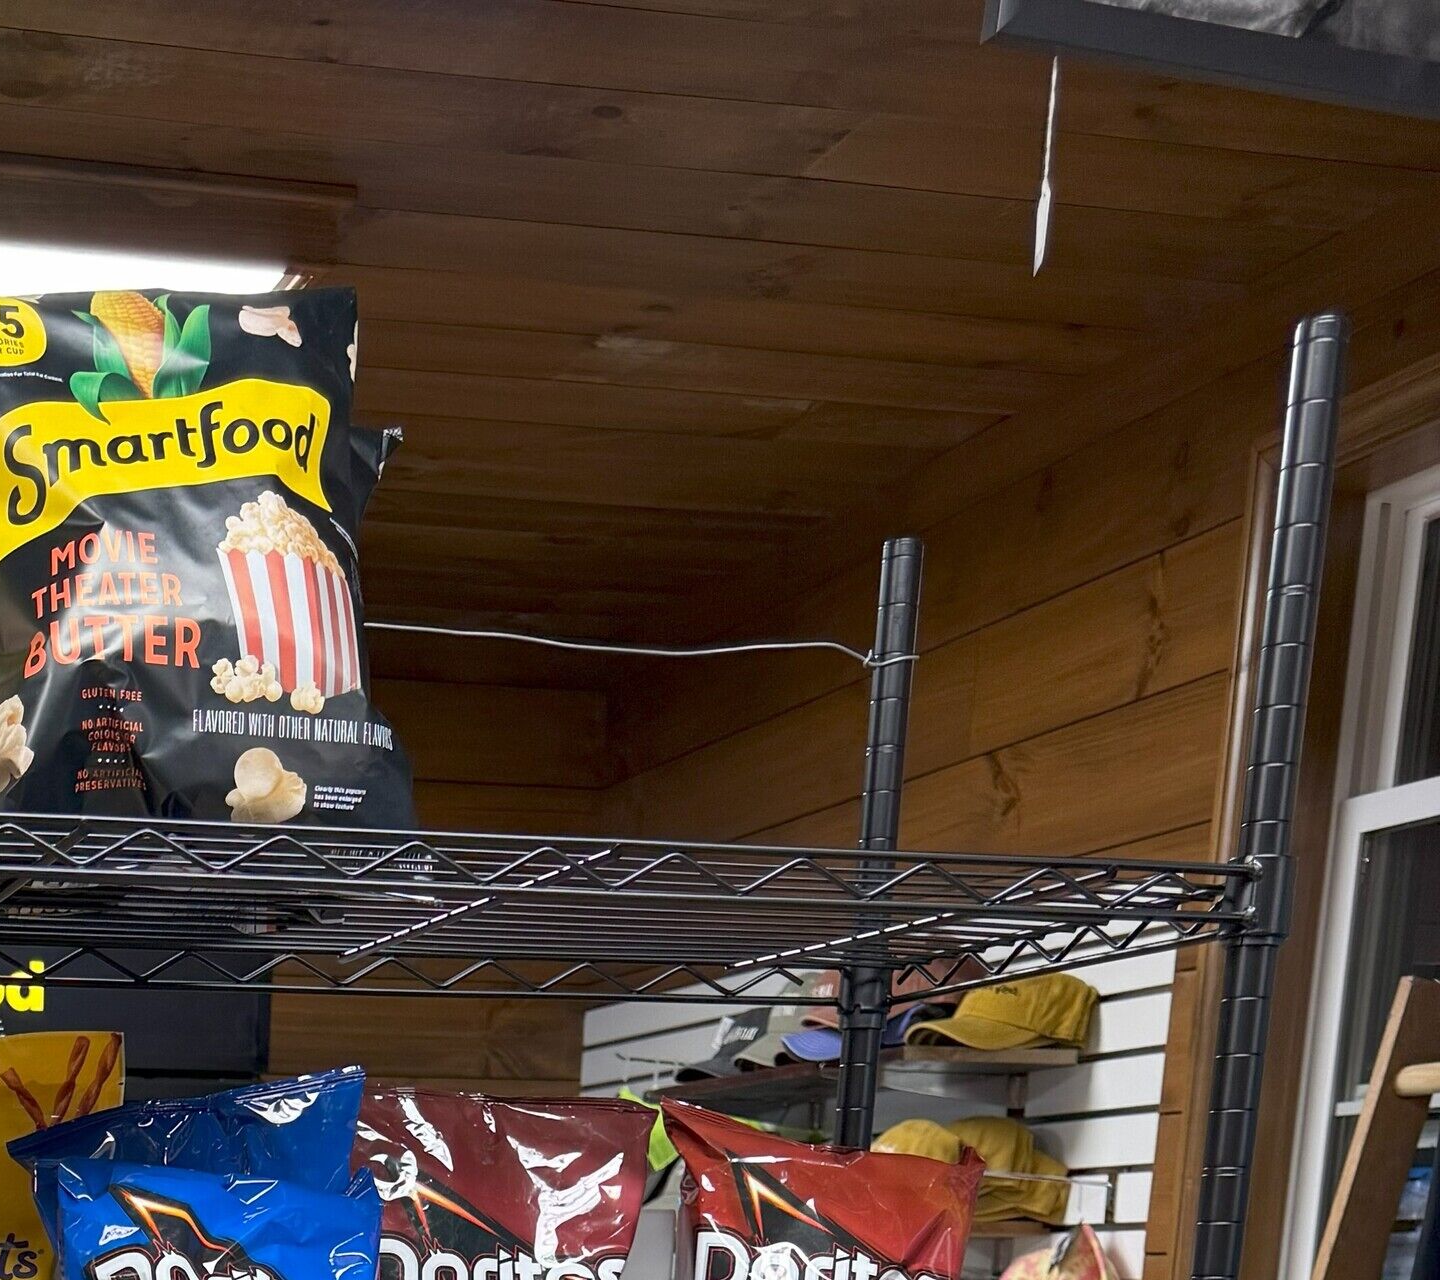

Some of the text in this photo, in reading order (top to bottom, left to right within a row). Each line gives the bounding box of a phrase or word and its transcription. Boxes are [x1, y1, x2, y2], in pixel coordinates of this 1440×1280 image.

[6, 347, 25, 355] CUP
[4, 402, 316, 526] Smartfood
[51, 530, 158, 577] MOVIE
[31, 573, 182, 620] THEATER
[24, 616, 201, 679] BUTTER
[81, 687, 143, 701] GLUTEN FREE
[82, 717, 144, 732] NO ARTIFICIAL
[192, 709, 359, 744] FLAVORED WITH OTHER NATURAL
